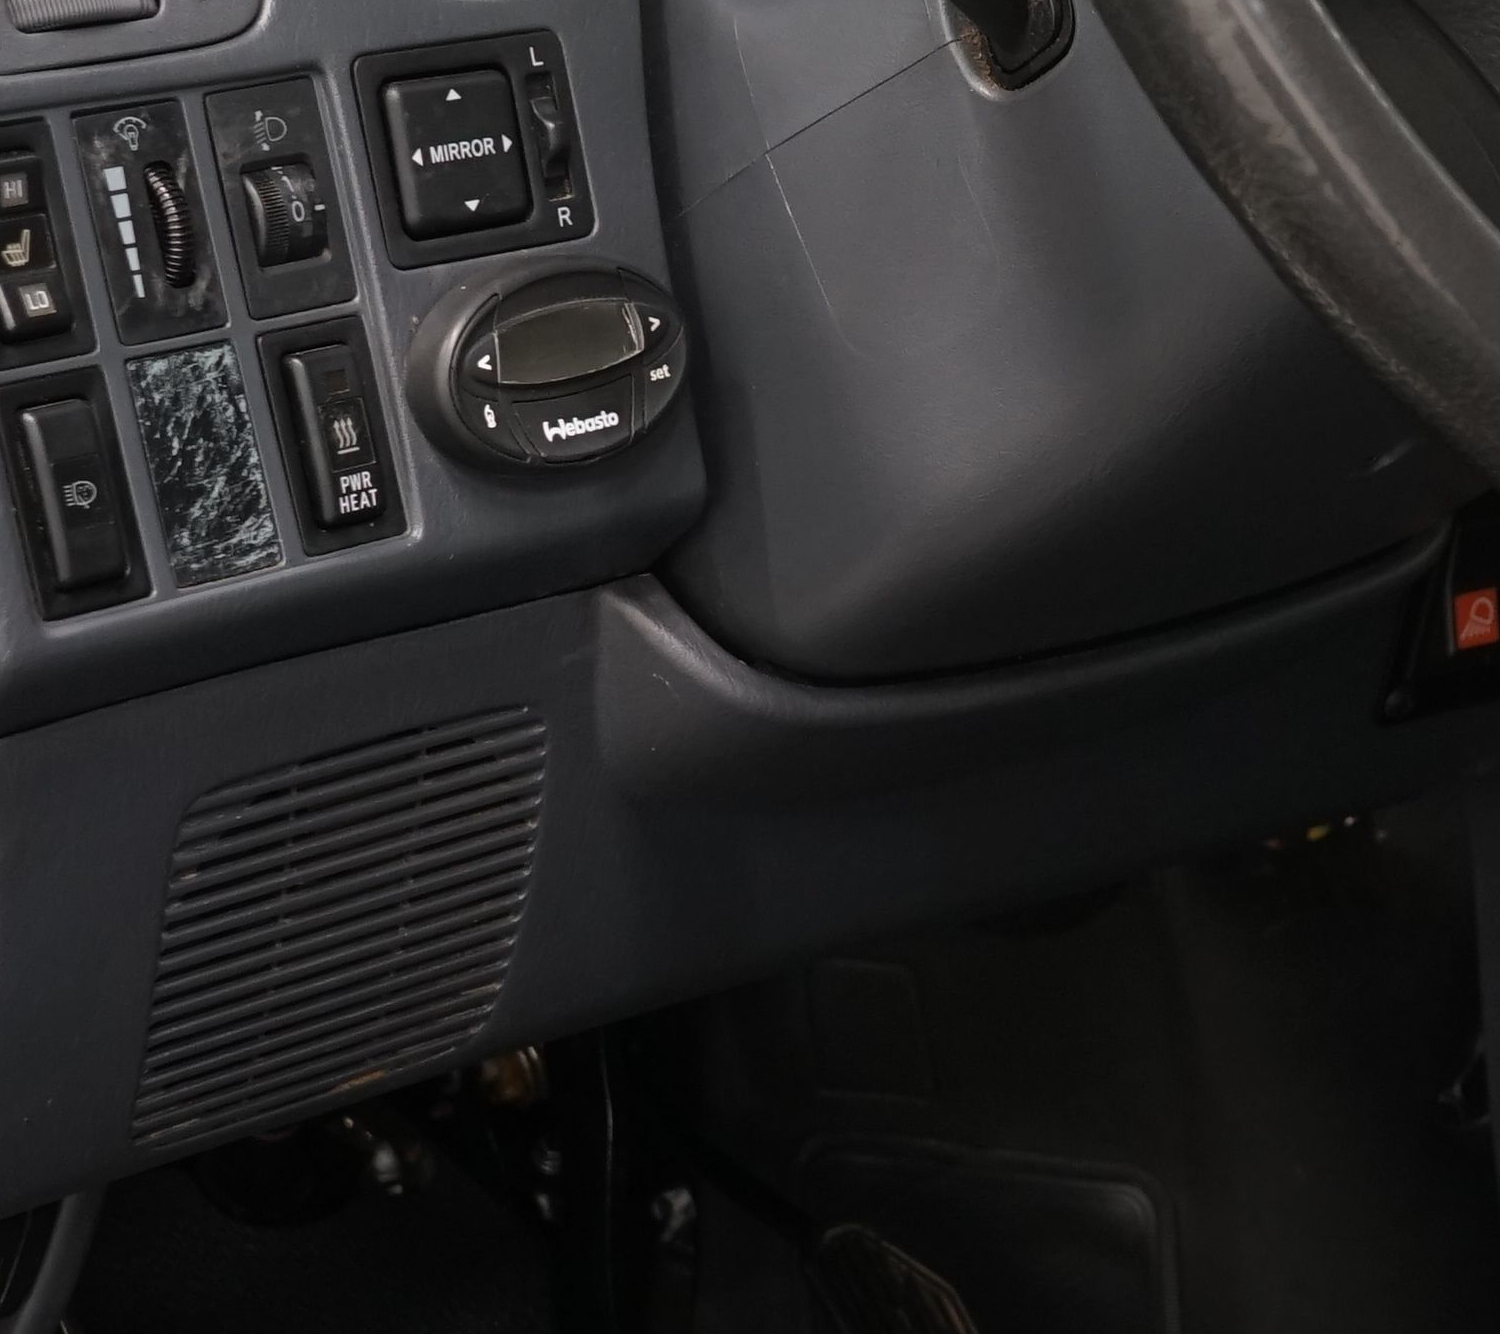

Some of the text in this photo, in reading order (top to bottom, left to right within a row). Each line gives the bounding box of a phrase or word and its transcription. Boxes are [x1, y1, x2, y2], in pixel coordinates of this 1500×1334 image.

[529, 46, 544, 67] L
[429, 137, 496, 165] MIRROR
[3, 179, 24, 199] HI
[291, 201, 305, 222] 0
[557, 207, 572, 227] R
[25, 290, 50, 311] LO
[649, 364, 670, 382] set
[543, 410, 619, 442] Webasto
[340, 471, 373, 492] PWR
[339, 489, 379, 514] HEAT
